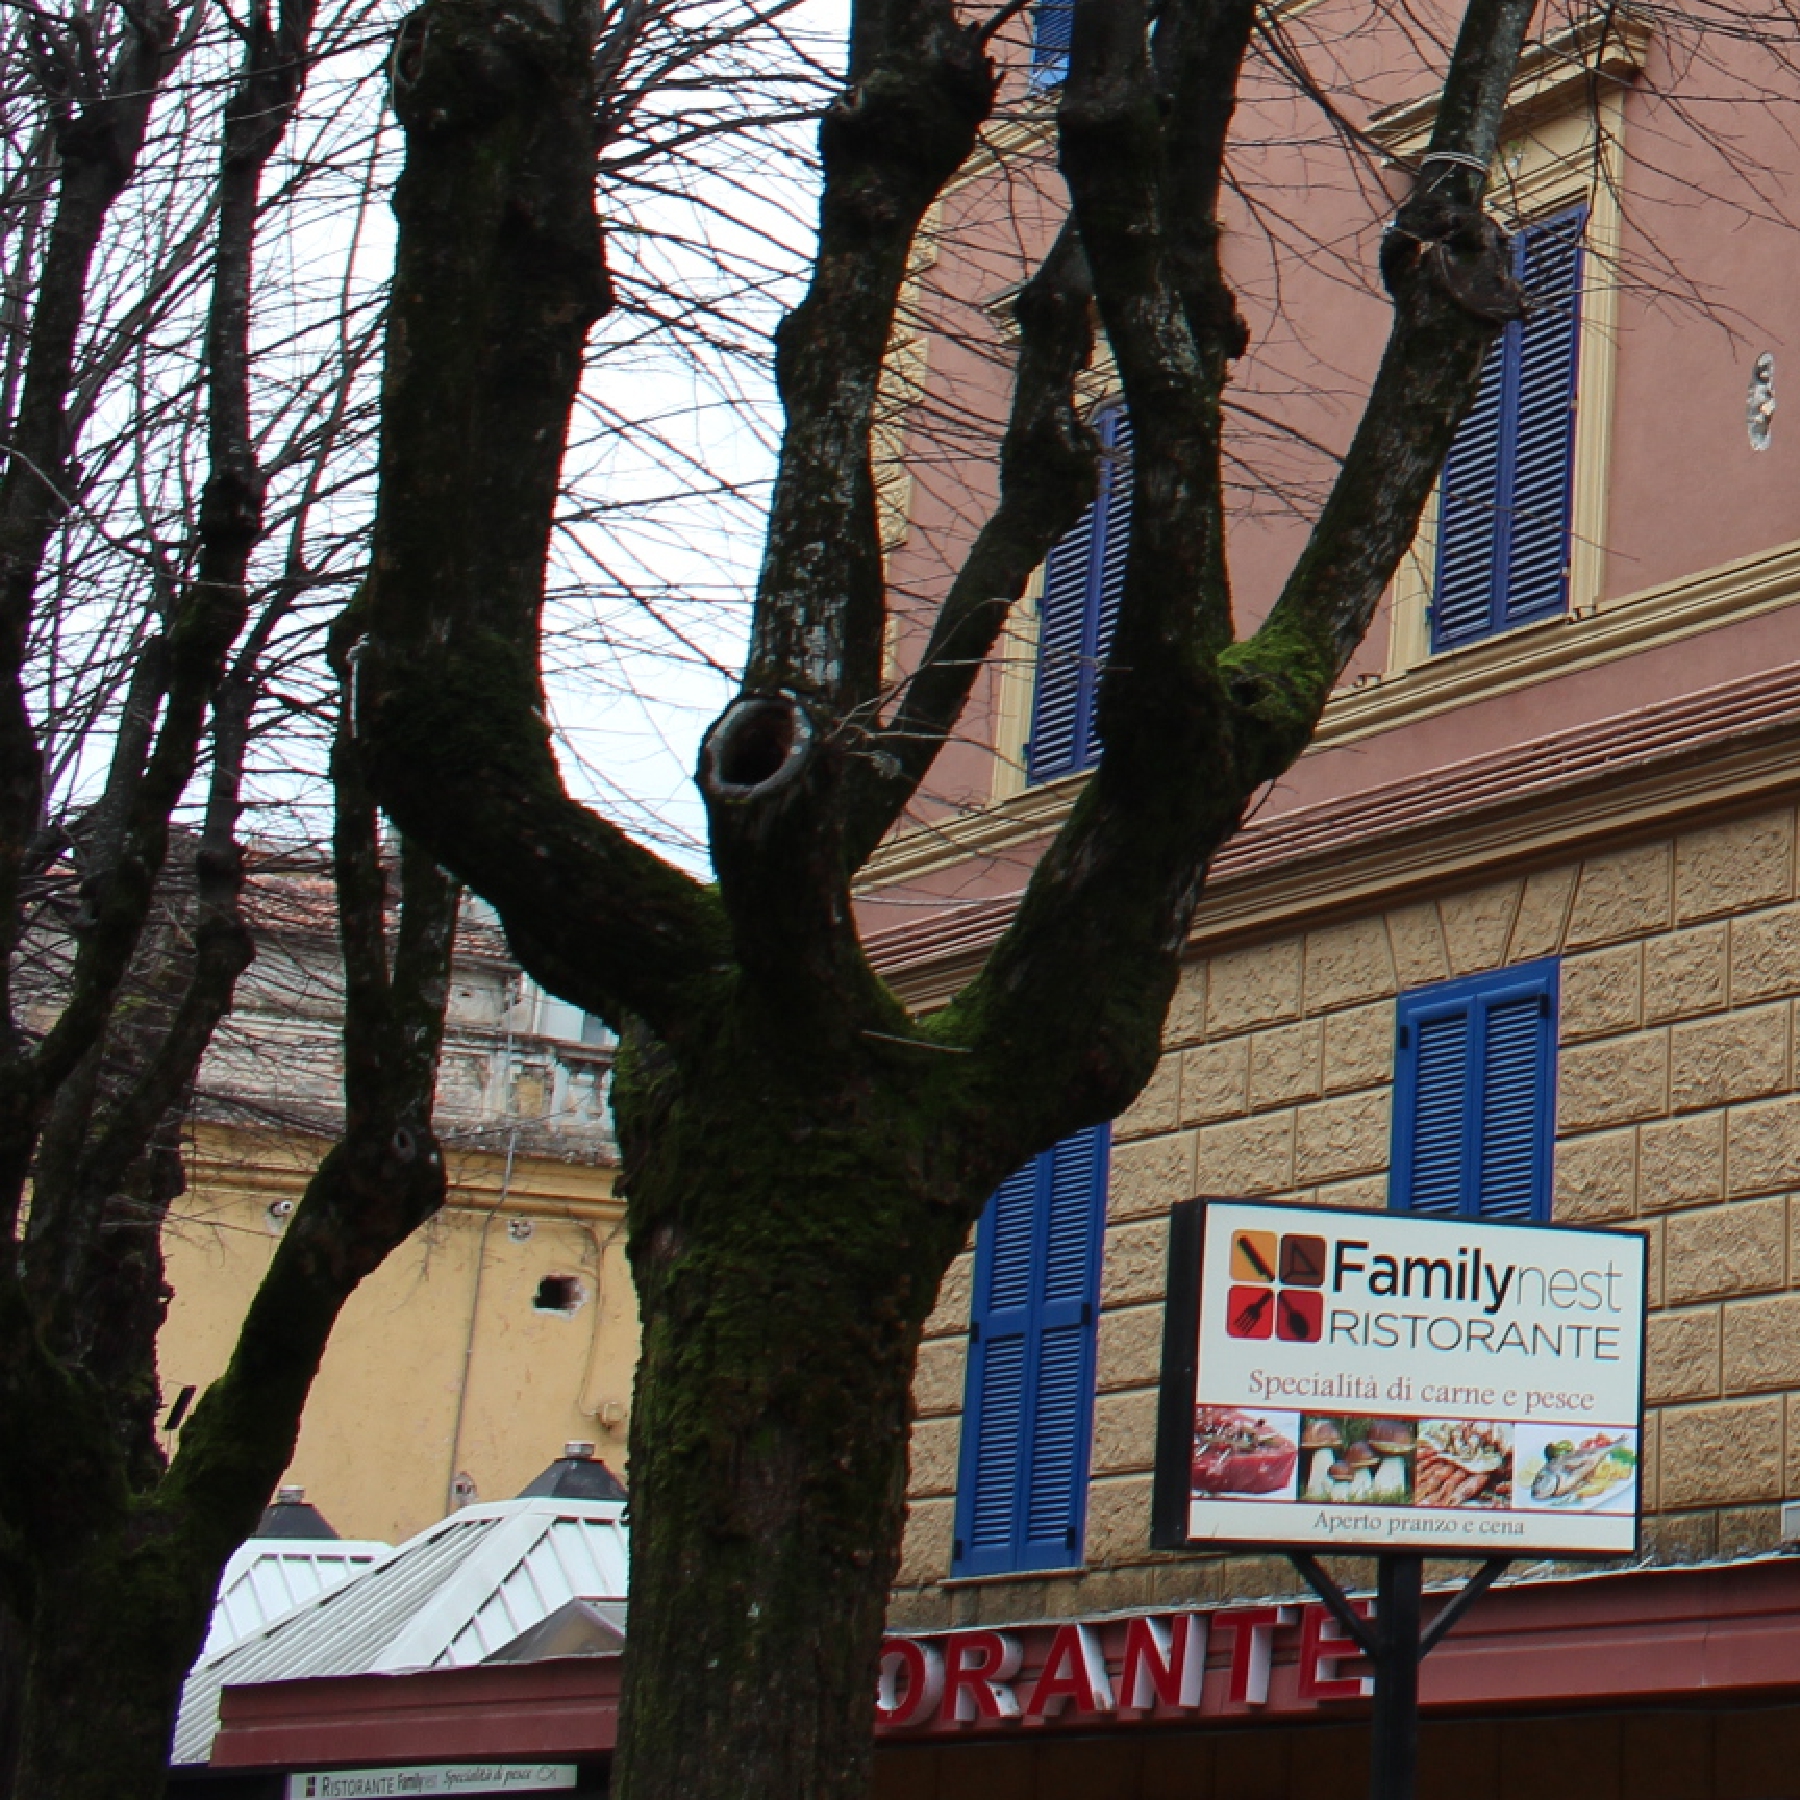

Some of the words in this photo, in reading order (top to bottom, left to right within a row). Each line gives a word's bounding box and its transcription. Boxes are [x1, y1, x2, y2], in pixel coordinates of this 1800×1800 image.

[1332, 1239, 1624, 1314] Familynest
[1328, 1308, 1621, 1361] RISTORANTE
[1248, 1368, 1379, 1400] Specialità
[1386, 1375, 1413, 1401] di
[1420, 1383, 1495, 1406] carne
[1502, 1390, 1519, 1407] e
[1525, 1390, 1596, 1415] pesce
[1313, 1509, 1383, 1534] Aperto
[1387, 1514, 1458, 1535] pranzo
[1461, 1518, 1475, 1534] e
[1478, 1518, 1525, 1536] cena
